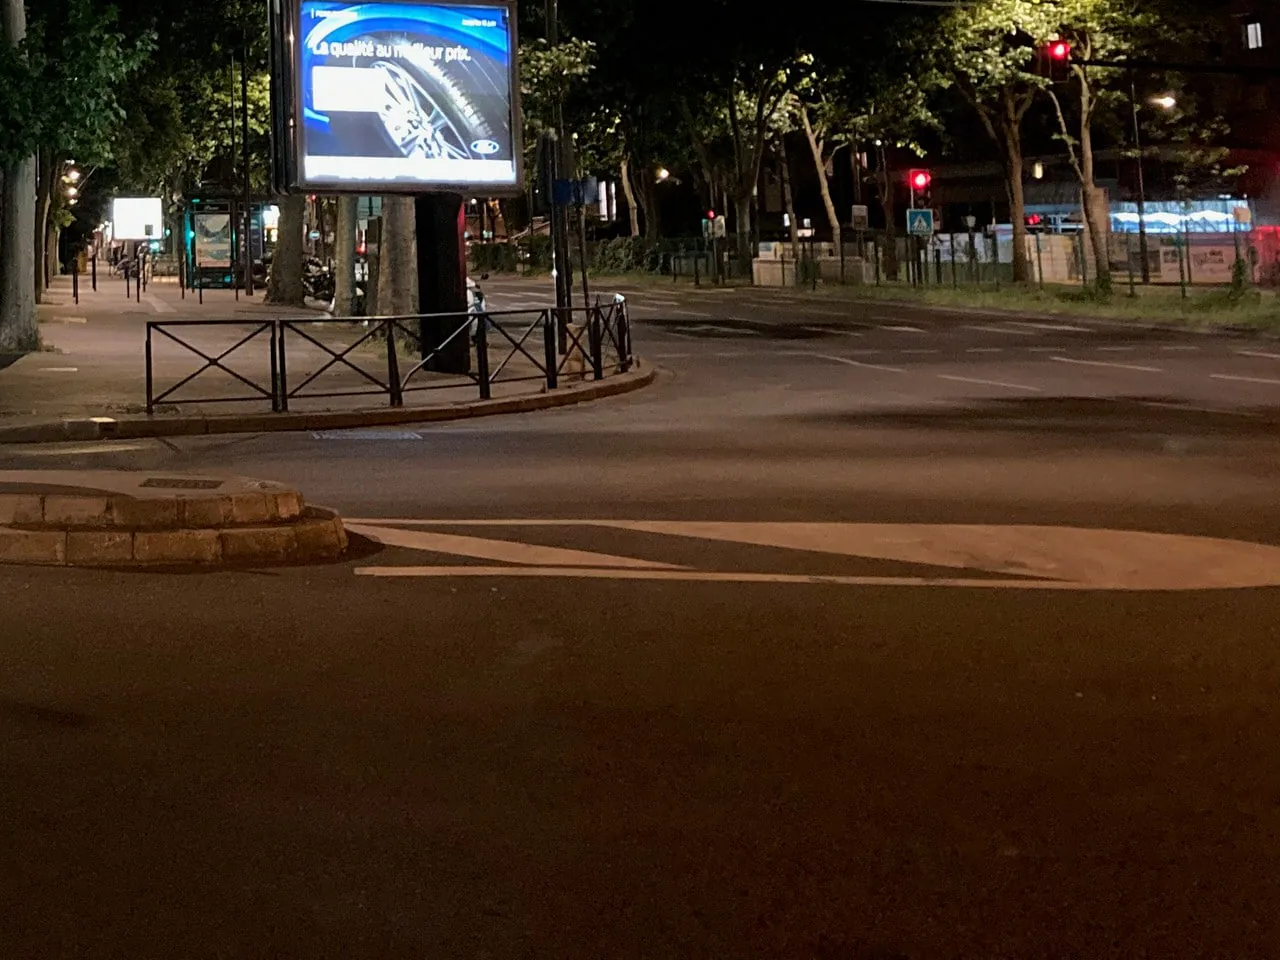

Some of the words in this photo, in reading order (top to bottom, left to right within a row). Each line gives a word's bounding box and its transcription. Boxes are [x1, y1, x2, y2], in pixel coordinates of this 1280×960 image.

[330, 40, 374, 59] qualité
[376, 44, 393, 58] au
[394, 42, 444, 60] mlleur
